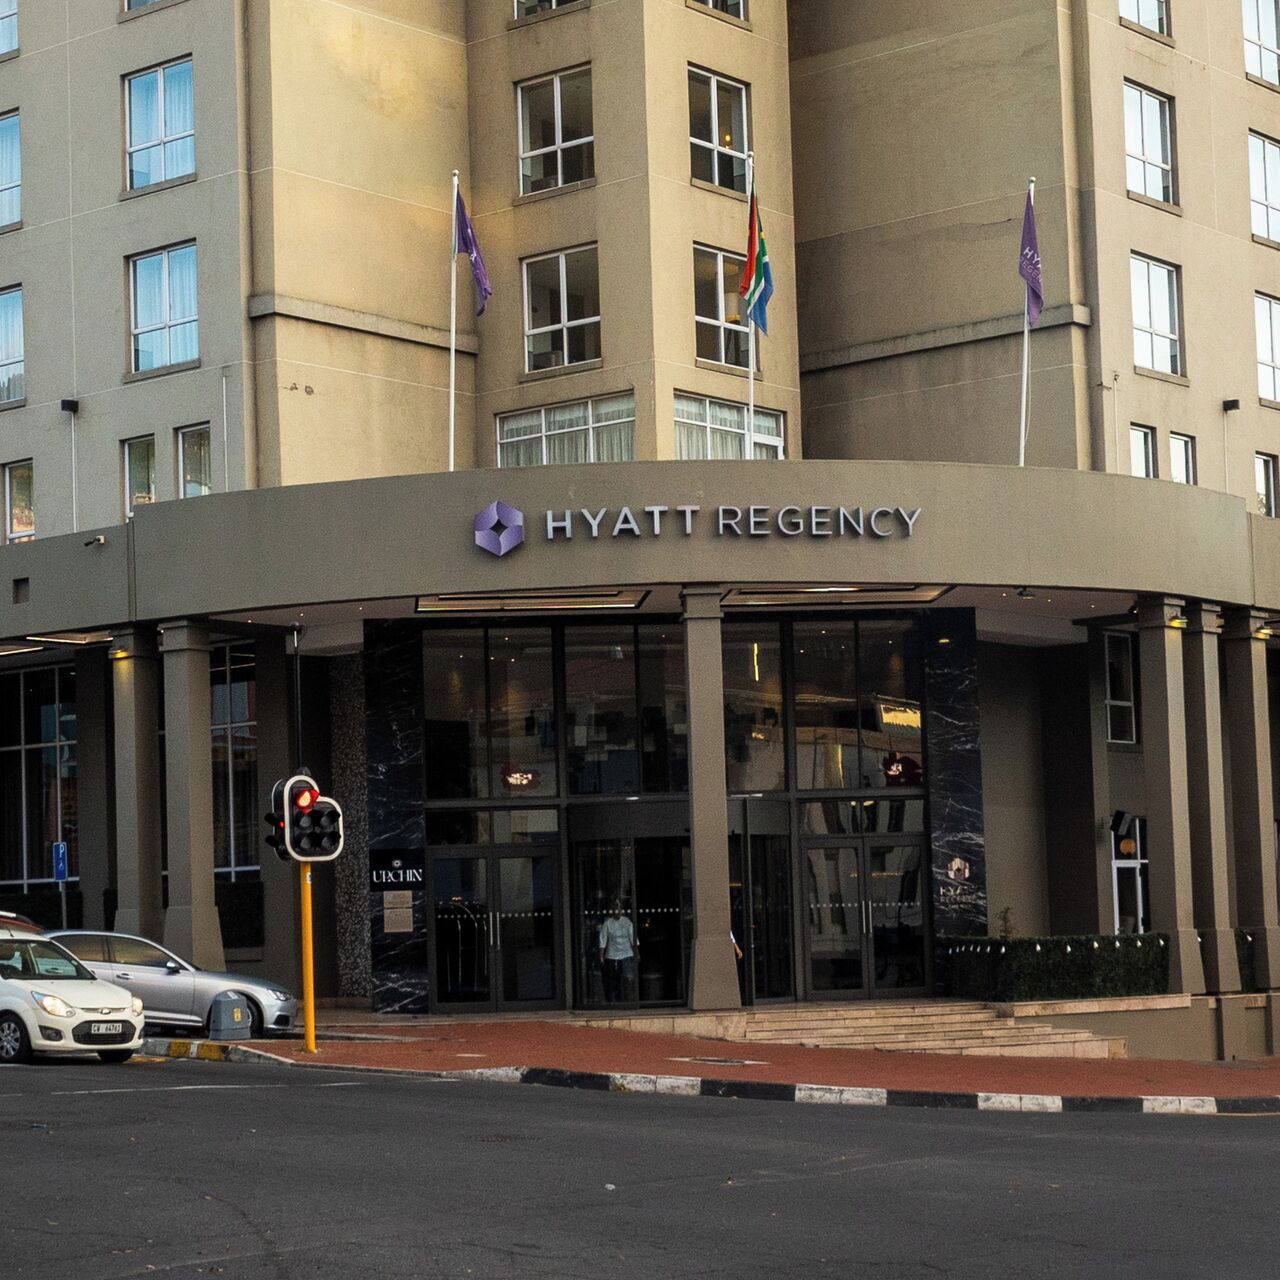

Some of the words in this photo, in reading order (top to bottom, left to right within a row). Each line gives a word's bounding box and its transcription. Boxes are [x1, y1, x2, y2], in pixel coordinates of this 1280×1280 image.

[546, 505, 701, 540] HYATT
[718, 505, 923, 538] REGENCY
[60, 844, 65, 858] P
[372, 869, 423, 883] URCHIN
